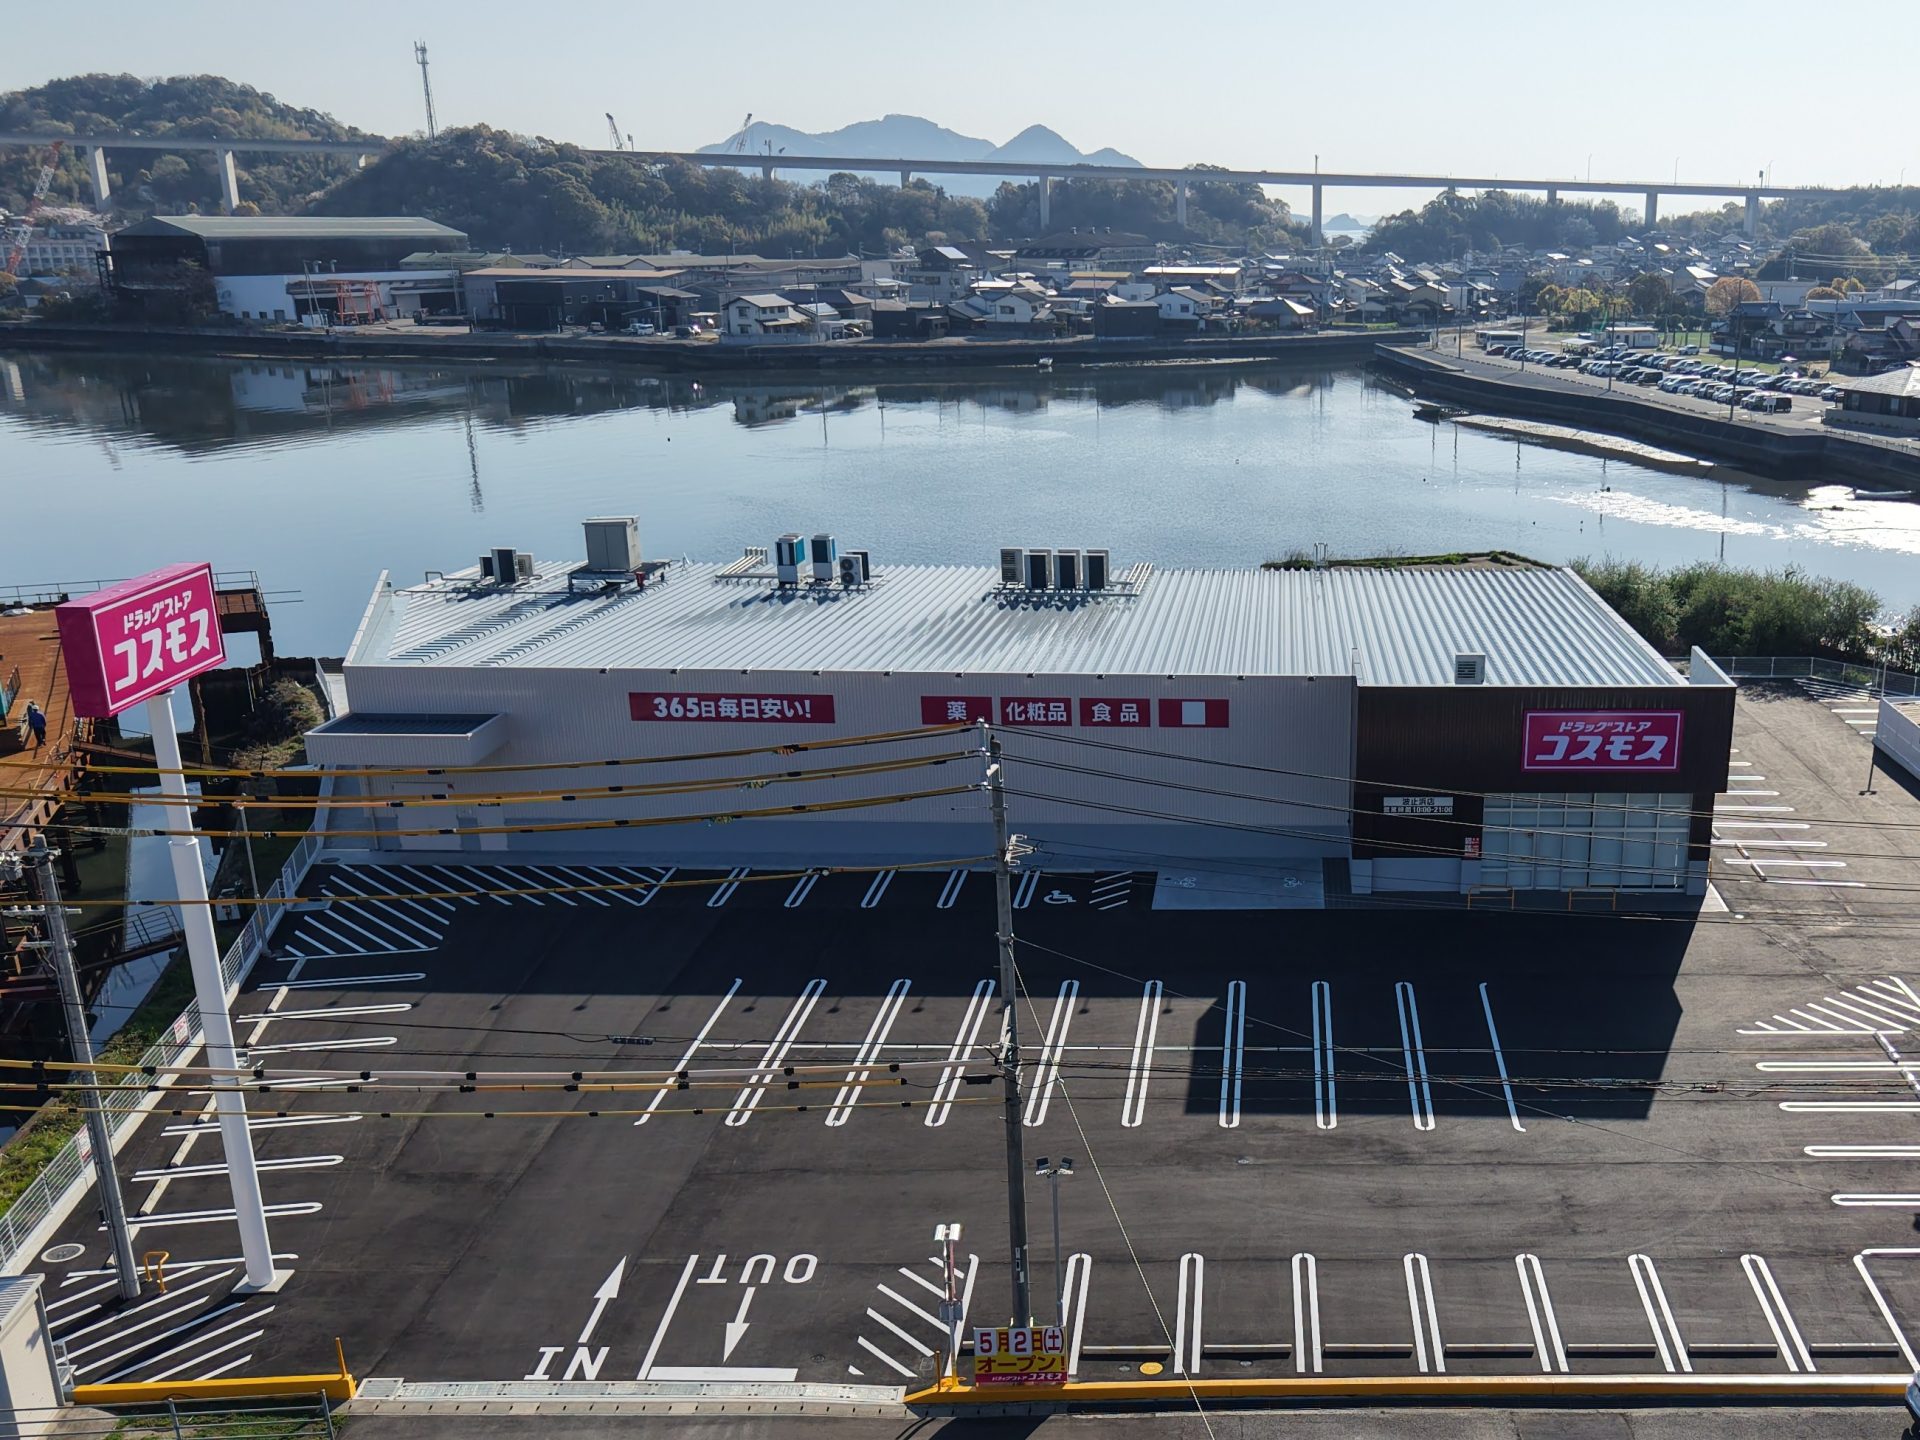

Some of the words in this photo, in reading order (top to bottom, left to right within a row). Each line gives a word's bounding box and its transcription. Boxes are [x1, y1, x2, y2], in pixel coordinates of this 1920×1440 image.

[124, 590, 192, 634] ドラッグストア
[114, 608, 210, 692] コスモス
[653, 697, 811, 718] 365日毎日安い!
[947, 701, 967, 721] 薬
[1006, 702, 1067, 722] 化粧品
[1092, 703, 1139, 722] 食品
[1559, 721, 1652, 733] ドラッグストア
[1535, 735, 1669, 761] コスモス
[697, 1254, 818, 1284] OUT
[979, 1328, 1064, 1353] 5月2日(土)
[523, 1347, 610, 1380] IN
[977, 1355, 1065, 1372] オープン!
